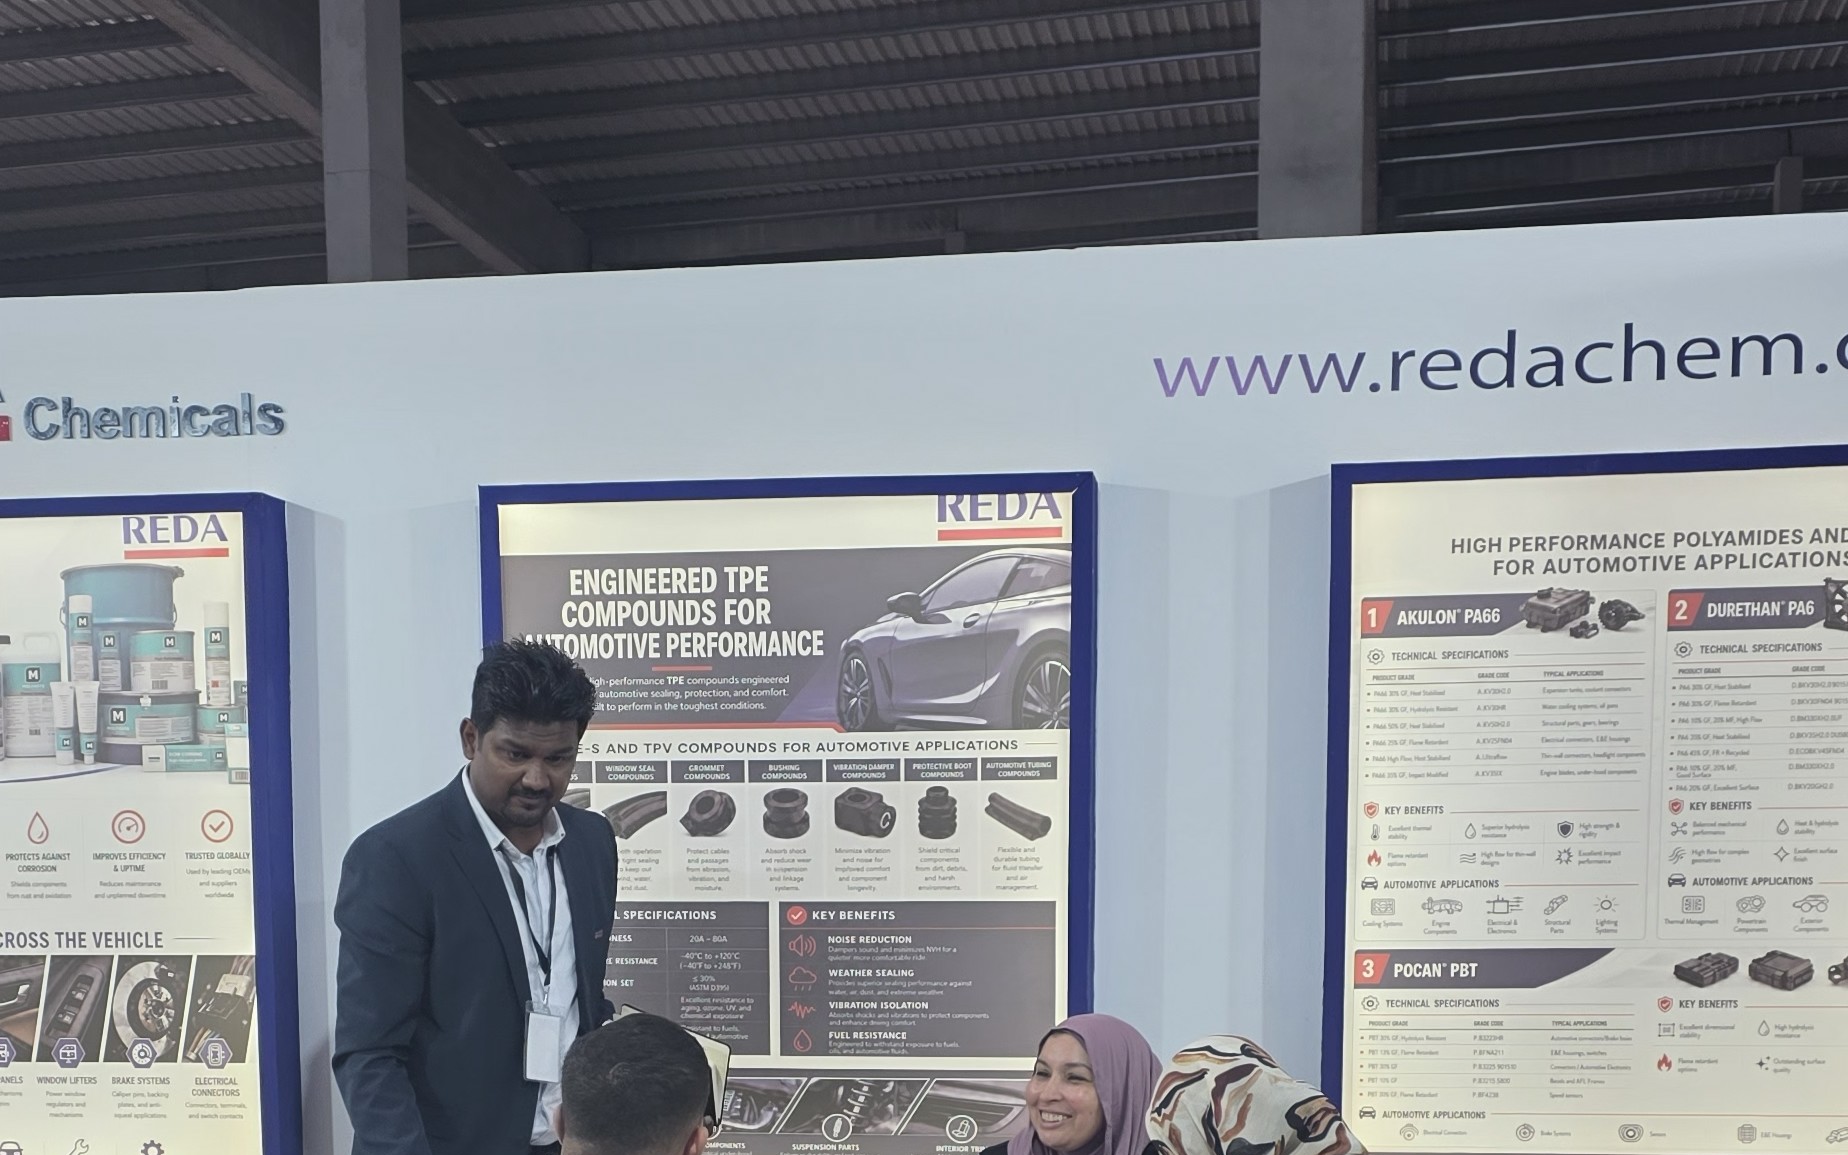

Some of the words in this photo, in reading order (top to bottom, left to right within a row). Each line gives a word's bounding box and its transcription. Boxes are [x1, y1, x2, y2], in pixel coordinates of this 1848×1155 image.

[23, 392, 285, 440] Chemicals
[937, 493, 1062, 522] REDA
[122, 514, 228, 544] REDA
[1451, 537, 1501, 554] HIGH
[1508, 532, 1665, 552] PERFORMANCE
[1674, 529, 1803, 547] POLYAMIDES
[1494, 559, 1535, 575] FOR
[1542, 554, 1686, 574] AUTOMOTIVE
[570, 566, 717, 595] ENGINEERED
[724, 566, 769, 593] TPE
[562, 599, 716, 628] COMPOUNDS
[724, 599, 770, 625] FOR
[1675, 600, 1687, 620] 2
[1788, 600, 1814, 616] PA6
[1367, 607, 1377, 627] 1
[1464, 608, 1500, 624] PA66
[667, 630, 824, 657] PERFORMANCE
[1700, 644, 1748, 654] TECHNICAL
[1752, 643, 1822, 653] SPECIFICATIONS
[1392, 651, 1437, 661] TECHNICAL
[1442, 650, 1509, 660] SPECIFICATIONS
[590, 676, 664, 687] igh-performance
[667, 677, 684, 685] TPE
[687, 677, 738, 686] compounds
[741, 675, 789, 686] engineered
[600, 689, 648, 698] automotive
[651, 689, 681, 699] sealing,
[685, 689, 731, 699] protection,
[734, 689, 749, 697] and
[752, 688, 788, 697] comfort.
[607, 703, 616, 711] to
[618, 703, 652, 713] perform
[665, 702, 677, 710] the
[680, 702, 718, 712] toughest
[720, 701, 766, 710] conditions.
[606, 743, 637, 753] AND
[644, 743, 672, 753] TPV
[678, 743, 776, 753] COMPOUNDS
[783, 743, 810, 752] FOR
[816, 741, 908, 752] AUTOMOTIVE
[915, 740, 1018, 751] APPLICATIONS
[1385, 806, 1401, 815] KEY
[1405, 806, 1444, 815] BENEFITS
[1690, 802, 1707, 810] KEY
[1711, 802, 1751, 810] BENEFITS
[185, 852, 214, 860] TRUSTED
[217, 852, 250, 860] GLOBALLY
[211, 868, 231, 876] leading
[211, 880, 237, 888] suppliers
[1384, 880, 1436, 889] AUTOMOTIVE
[1440, 880, 1499, 888] APPLICATIONS
[1693, 878, 1748, 886] AUTOMOTIVE
[1751, 877, 1813, 885] APPLICATIONS
[624, 911, 716, 920] SPECIFICATIONS
[812, 911, 835, 920] KEY
[840, 911, 895, 920] BENEFITS
[55, 931, 86, 948] THE
[92, 931, 163, 948] VEHICLE
[828, 936, 856, 944] NOISE
[859, 936, 912, 944] REDUCTION
[829, 969, 872, 977] WEATHER
[876, 969, 914, 977] SEALING
[1362, 960, 1374, 977] 3
[1450, 963, 1478, 977] PBT
[1386, 1000, 1430, 1008] TECHNICAL
[1434, 1000, 1499, 1008] SPECIFICATIONS
[1679, 1000, 1695, 1008] KEY
[1699, 1000, 1738, 1008] BENEFITS
[112, 1077, 135, 1085] BRAKE
[137, 1077, 170, 1085] SYSTEMS
[195, 1077, 238, 1085] ELECTRICAL
[192, 1089, 240, 1097] CONNECTORS
[1382, 1111, 1430, 1119] AUTOMOTIVE
[1433, 1111, 1486, 1119] APPLICATIONS
